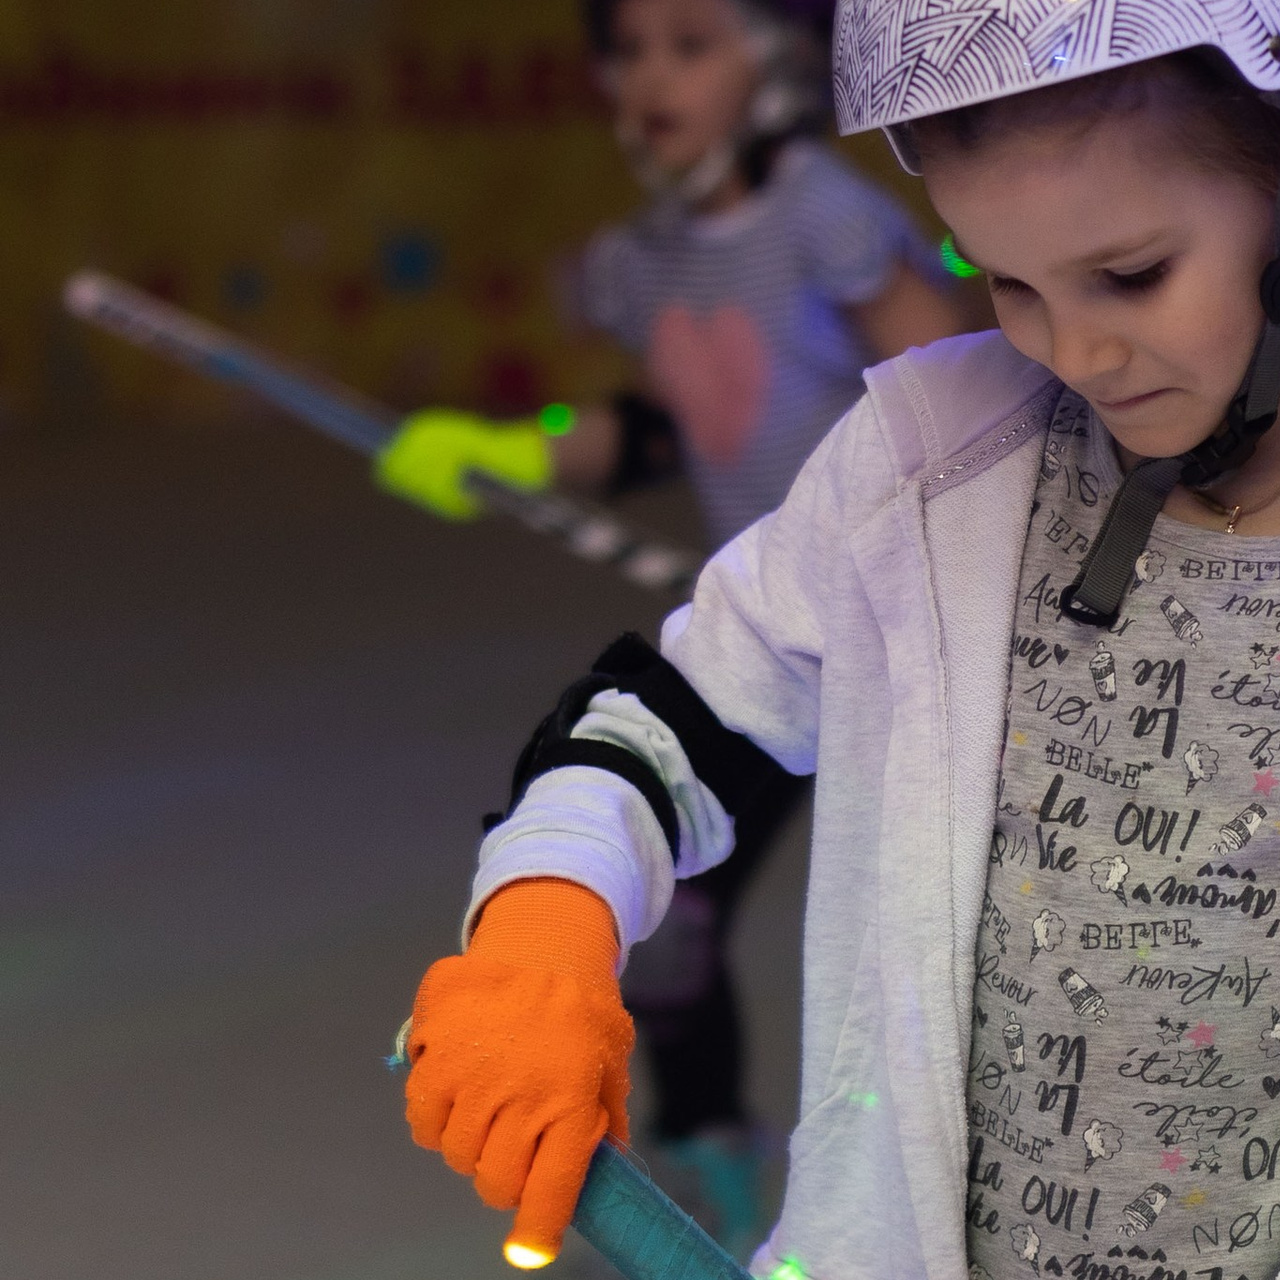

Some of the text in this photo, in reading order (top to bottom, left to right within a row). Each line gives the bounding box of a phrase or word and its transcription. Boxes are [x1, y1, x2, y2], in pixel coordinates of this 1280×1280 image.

[1046, 738, 1142, 789] BELLE
[1039, 773, 1089, 828] La
[1036, 823, 1078, 872] Vie
[1114, 802, 1201, 863] OUI!
[1118, 1048, 1245, 1088] étoile
[1022, 1175, 1100, 1241] OUI!
